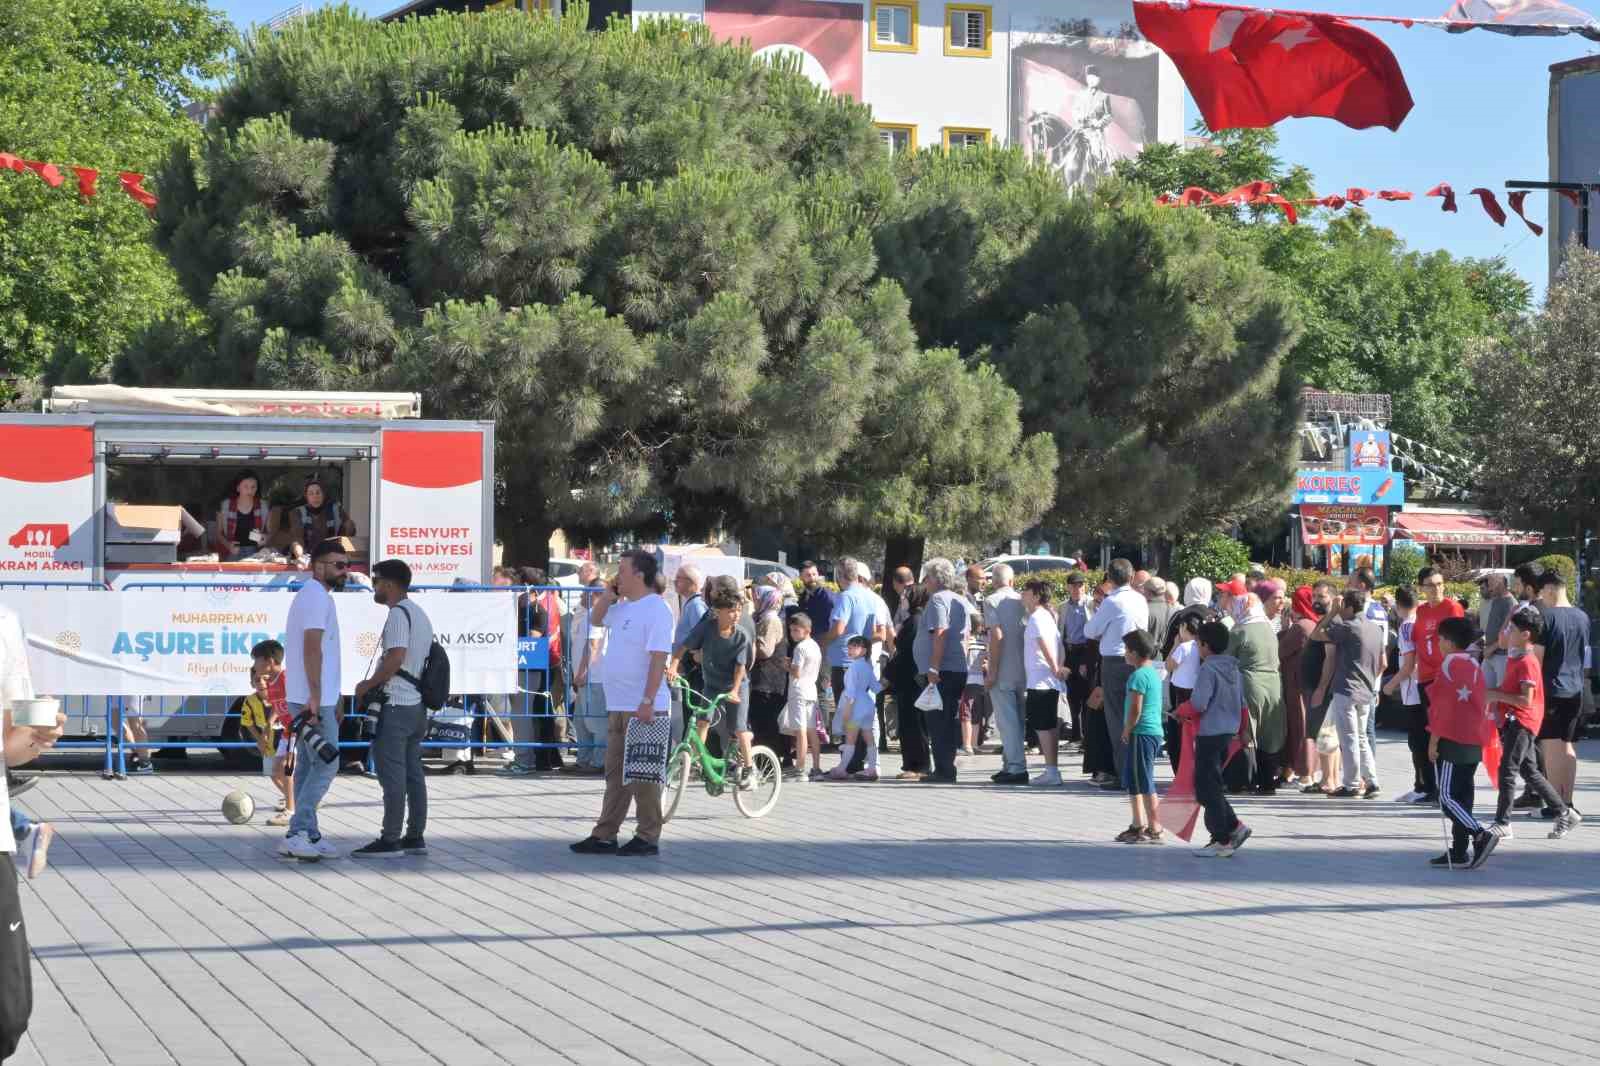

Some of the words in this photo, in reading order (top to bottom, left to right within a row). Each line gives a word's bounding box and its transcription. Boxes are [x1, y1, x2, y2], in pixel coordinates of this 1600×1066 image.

[390, 527, 470, 538] ESENYURT
[386, 542, 473, 555] BELEDİYESİ
[0, 560, 37, 570] KRAM
[41, 560, 84, 570] ARACI
[408, 562, 422, 571] AN
[426, 562, 459, 571] AKSOY
[172, 612, 243, 623] MUHARREM
[246, 612, 267, 623] AYI
[432, 633, 450, 644] AN
[456, 632, 504, 644] AKSOY
[111, 631, 214, 661] AŞURE
